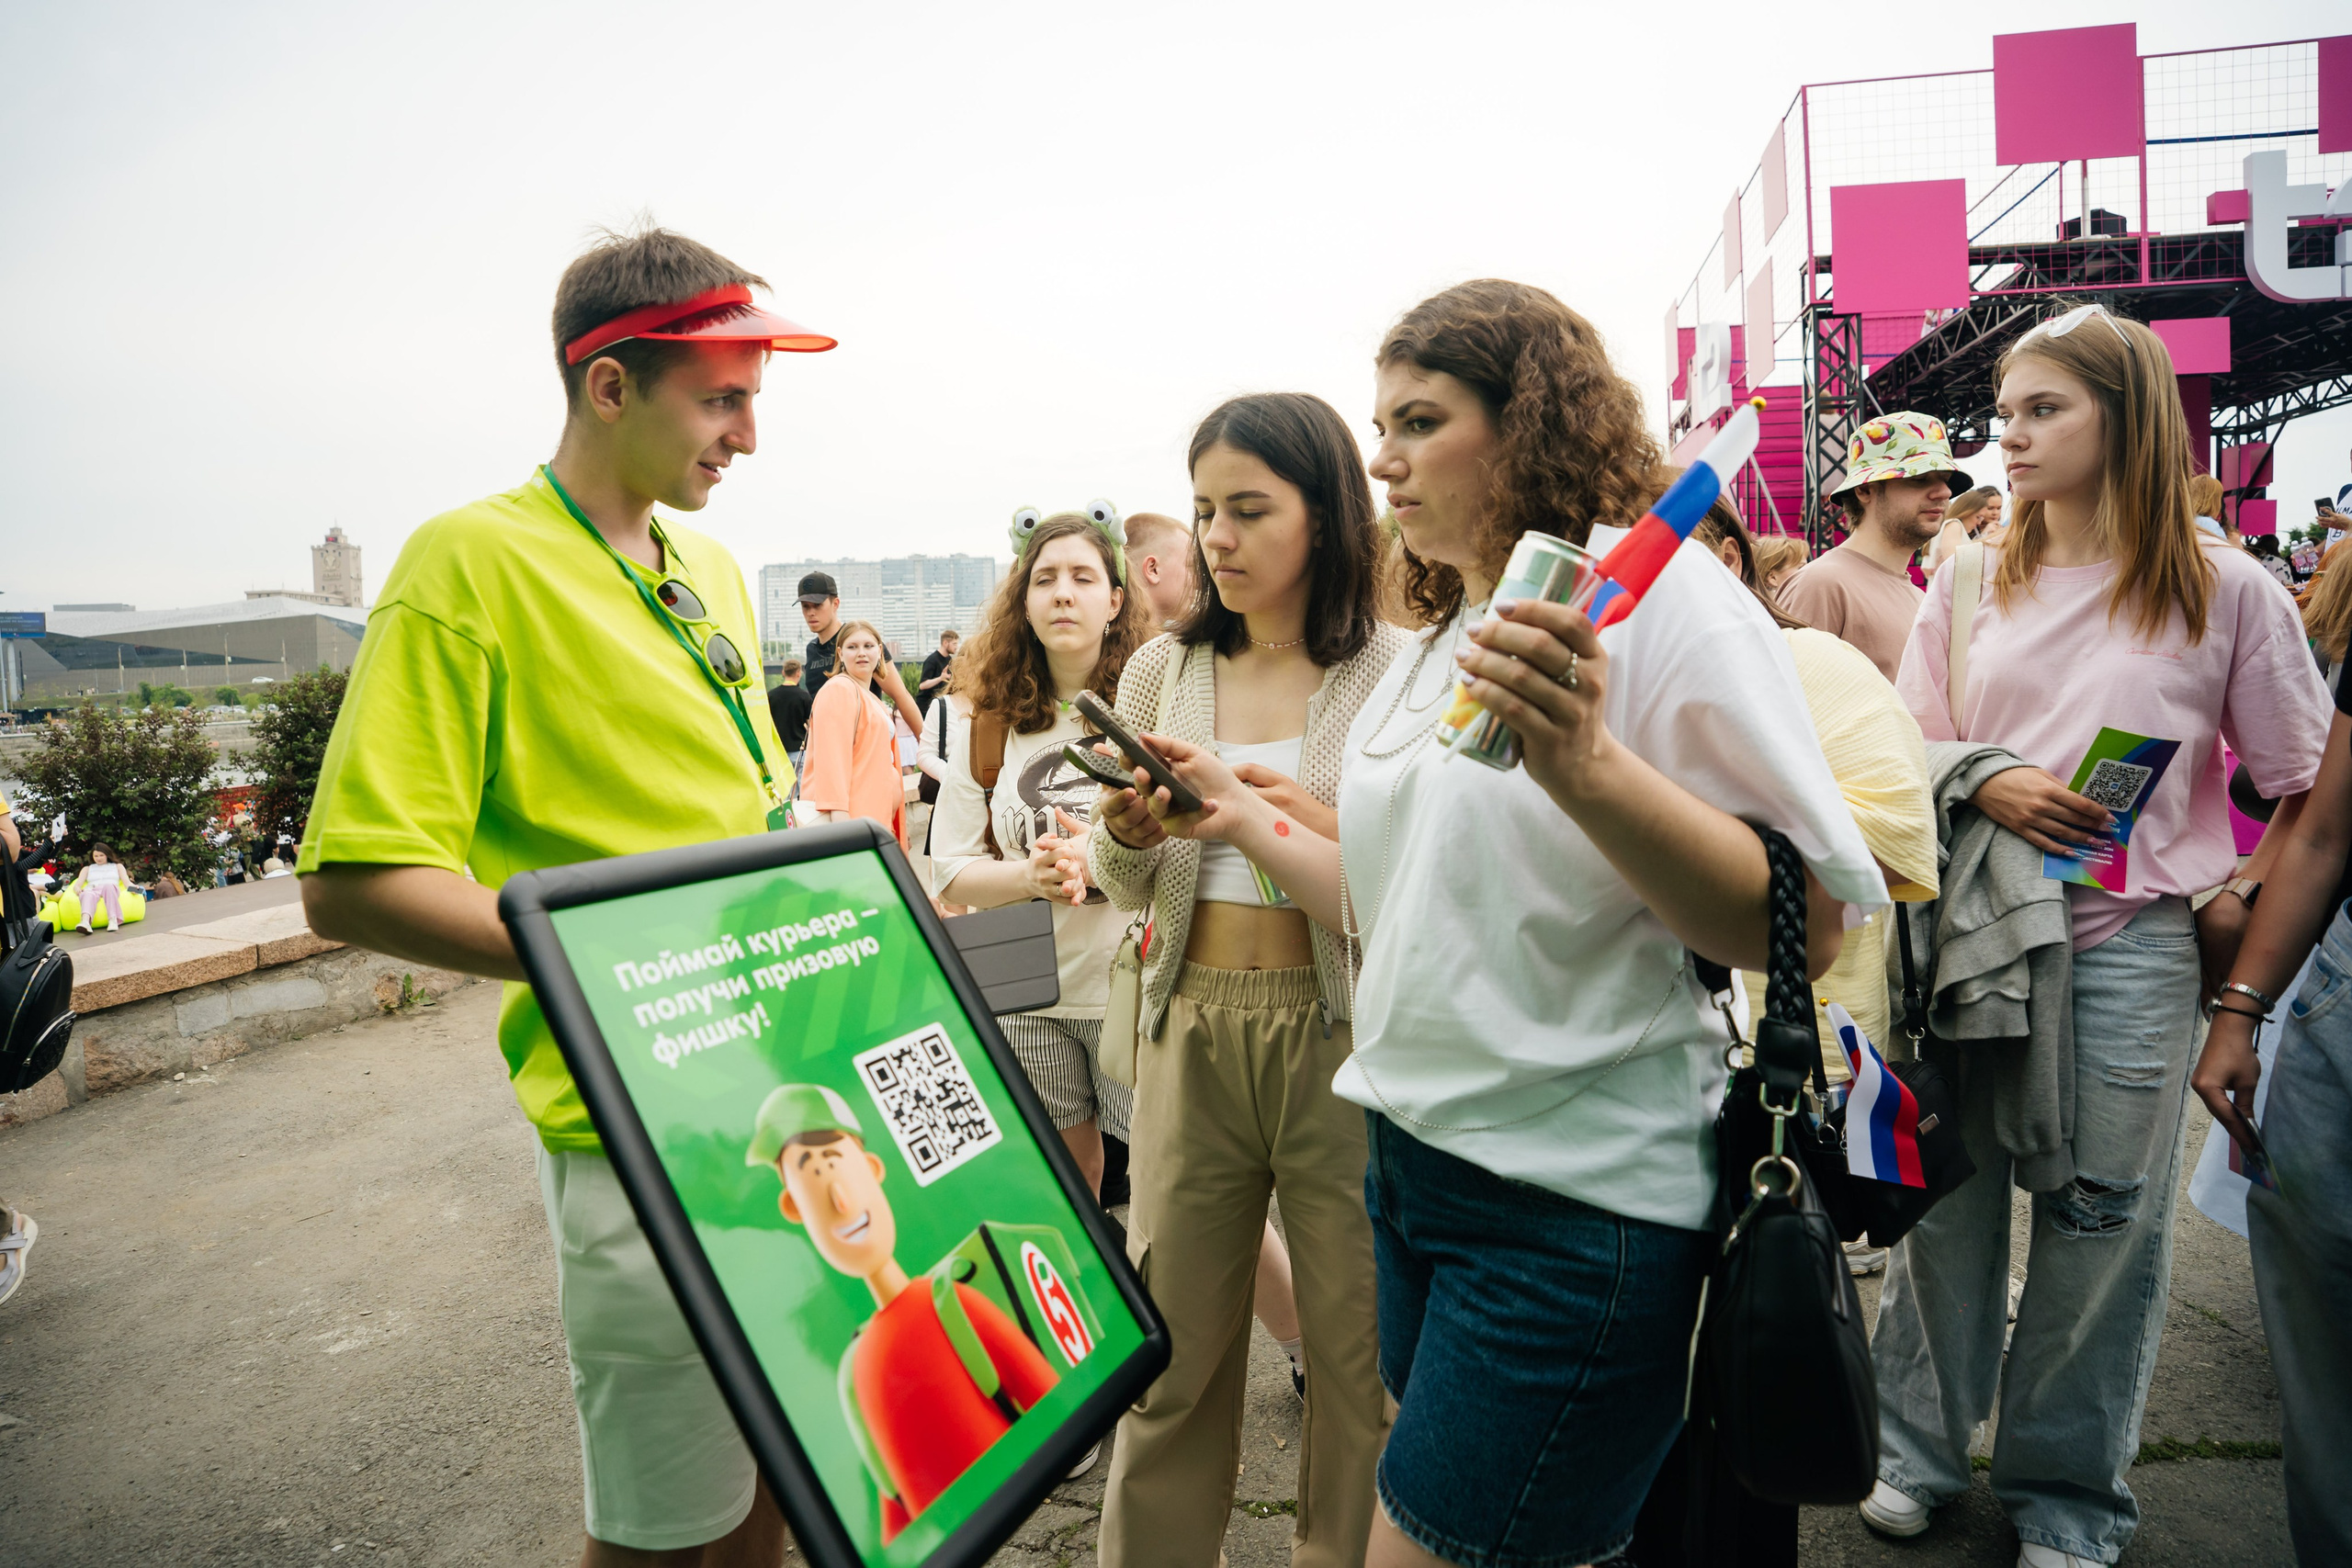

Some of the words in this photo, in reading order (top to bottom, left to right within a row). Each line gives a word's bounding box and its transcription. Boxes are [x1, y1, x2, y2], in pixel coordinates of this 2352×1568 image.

[2243, 150, 2352, 303] t
[613, 934, 745, 991] Поймай
[746, 908, 857, 955] курьера
[633, 974, 751, 1028] получи
[752, 936, 879, 991] призовую
[652, 1002, 772, 1069] фишку!
